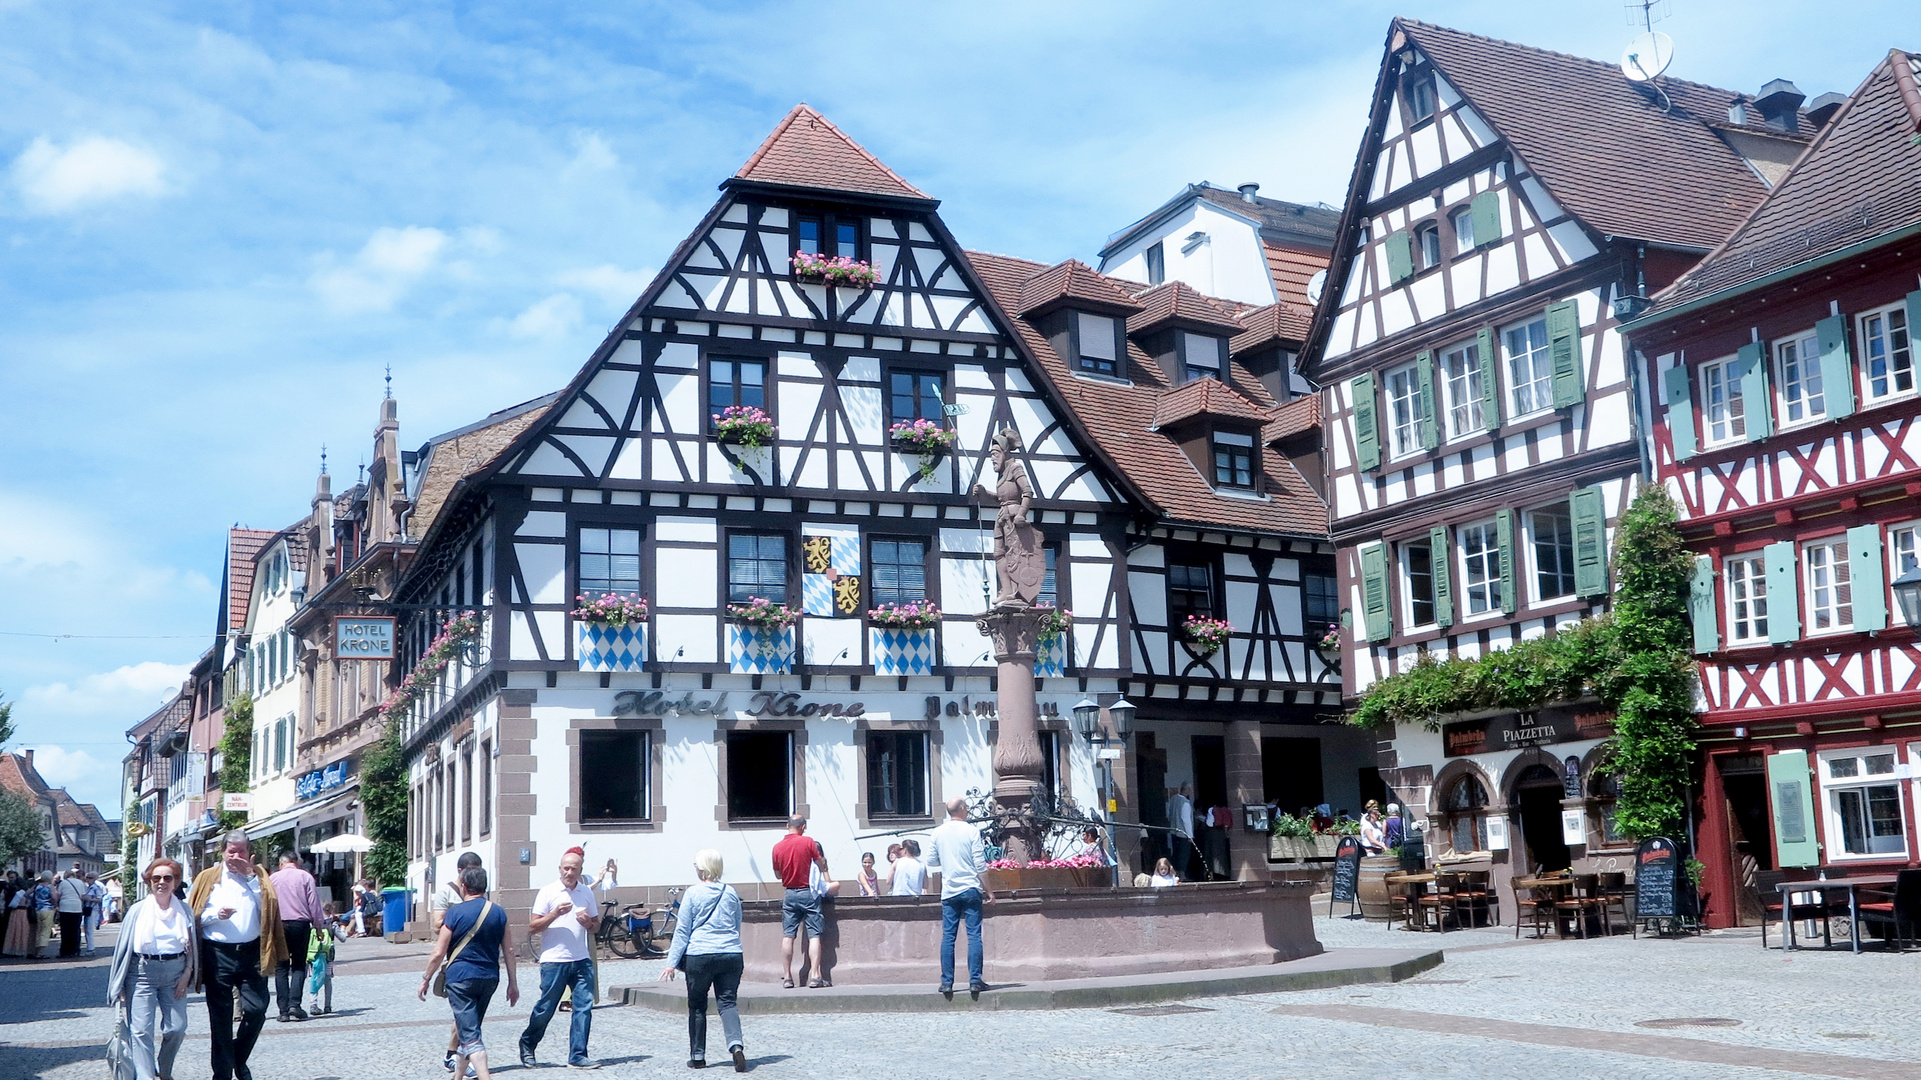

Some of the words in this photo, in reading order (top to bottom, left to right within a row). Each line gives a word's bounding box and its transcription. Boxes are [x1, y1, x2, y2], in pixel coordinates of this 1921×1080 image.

[344, 624, 386, 636] HOTEL
[340, 638, 390, 653] KRONE
[611, 690, 729, 717] Hotel
[745, 691, 866, 718] Krone
